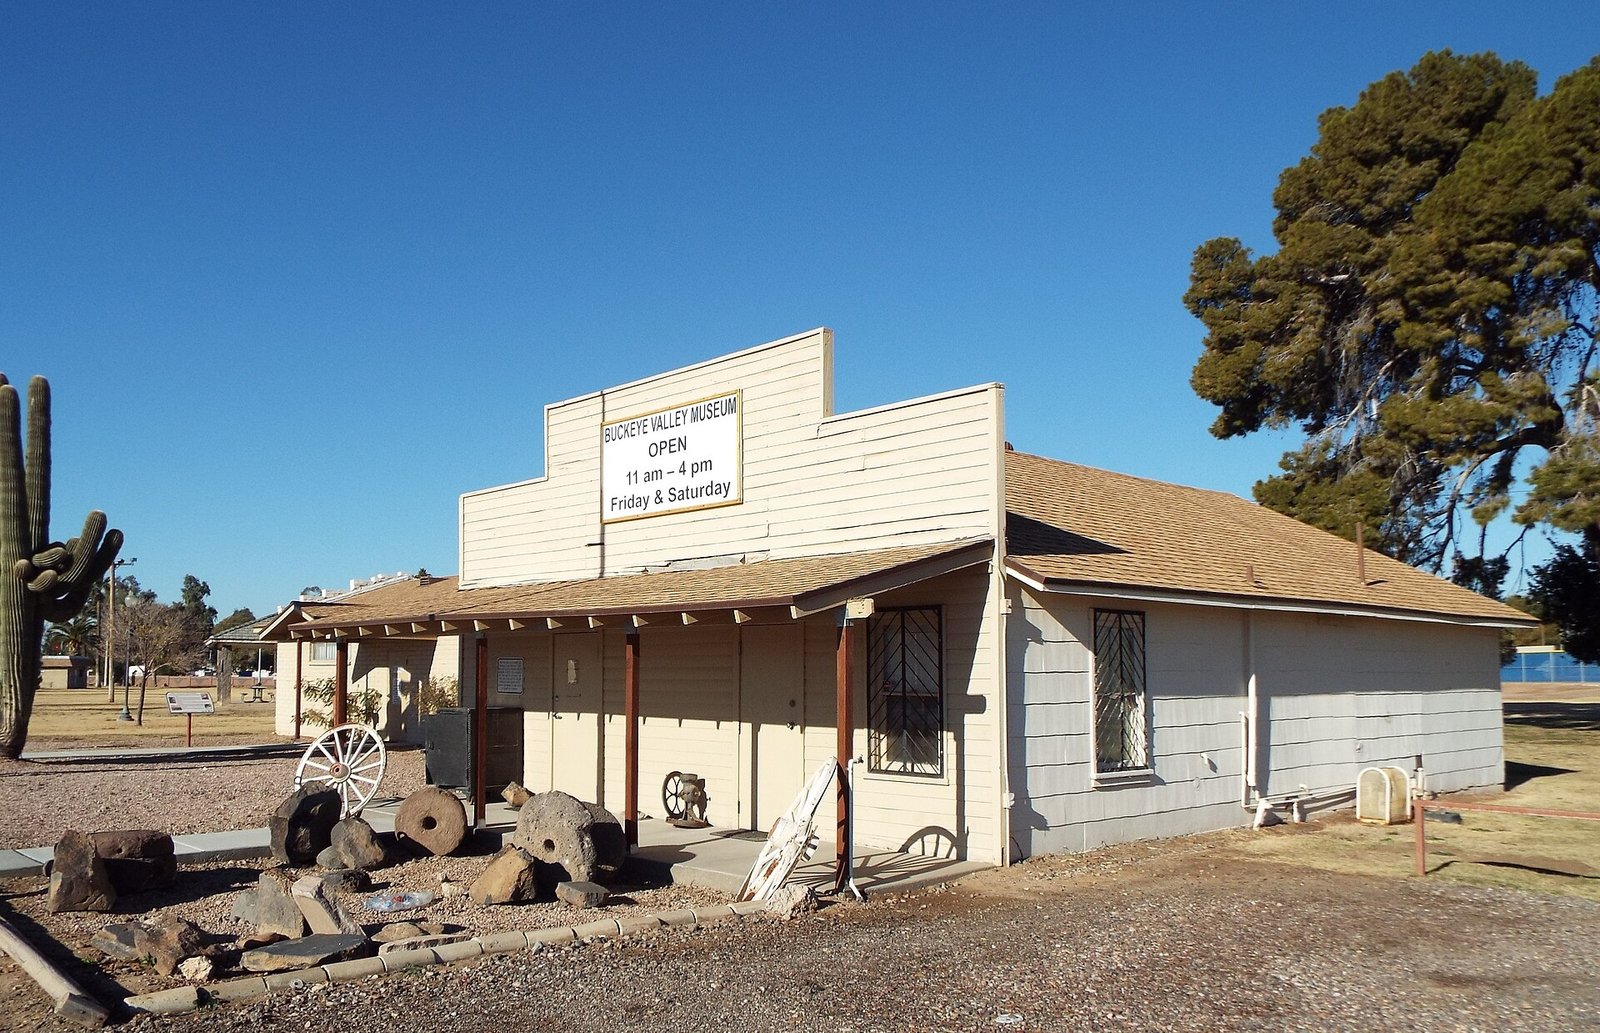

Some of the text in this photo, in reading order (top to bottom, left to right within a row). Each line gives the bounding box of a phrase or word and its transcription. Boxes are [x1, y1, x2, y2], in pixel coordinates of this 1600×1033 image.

[605, 397, 736, 443] BUCKEYE VALLEY MUSEUM
[648, 436, 687, 457] OPEN
[626, 470, 638, 485] 11
[644, 469, 662, 482] am
[679, 460, 686, 475] 4
[691, 459, 712, 478] pm
[611, 480, 731, 511] Friday & Saturday
